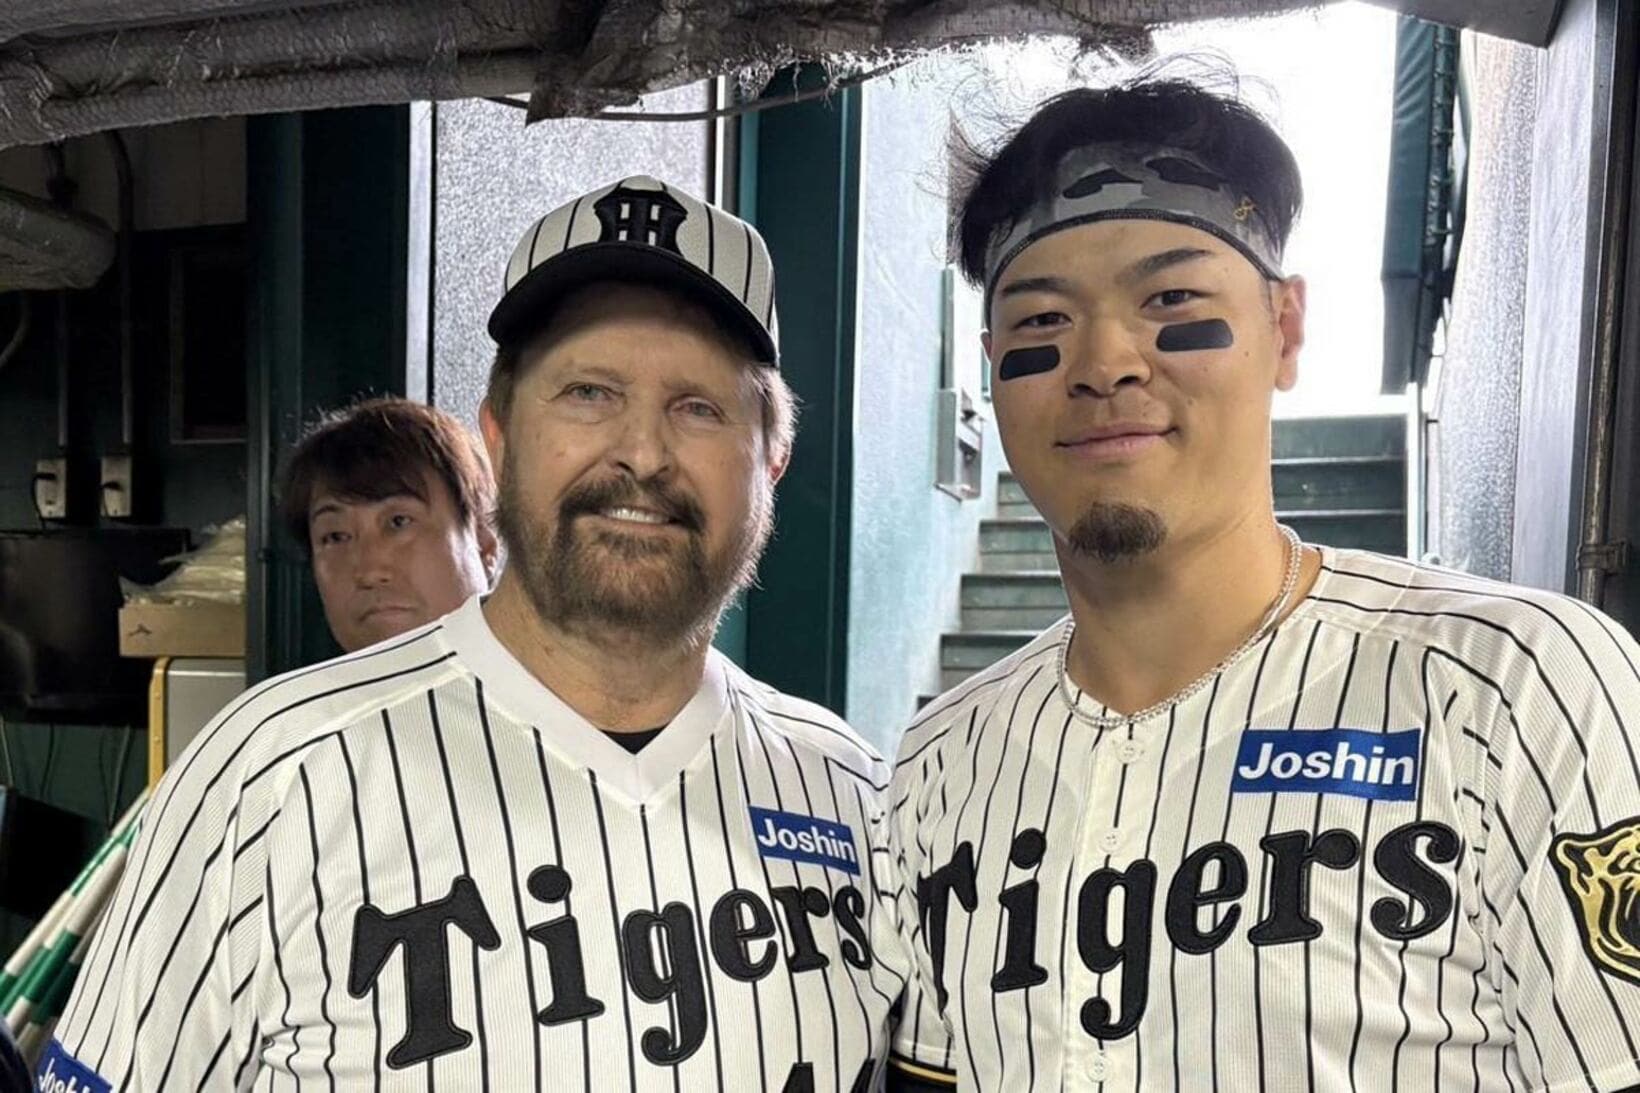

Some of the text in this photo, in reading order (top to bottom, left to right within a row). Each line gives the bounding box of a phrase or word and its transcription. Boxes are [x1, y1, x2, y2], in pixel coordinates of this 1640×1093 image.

[1239, 742, 1415, 785] Joshin
[758, 818, 856, 863] Joshin
[348, 865, 872, 1068] Tigers
